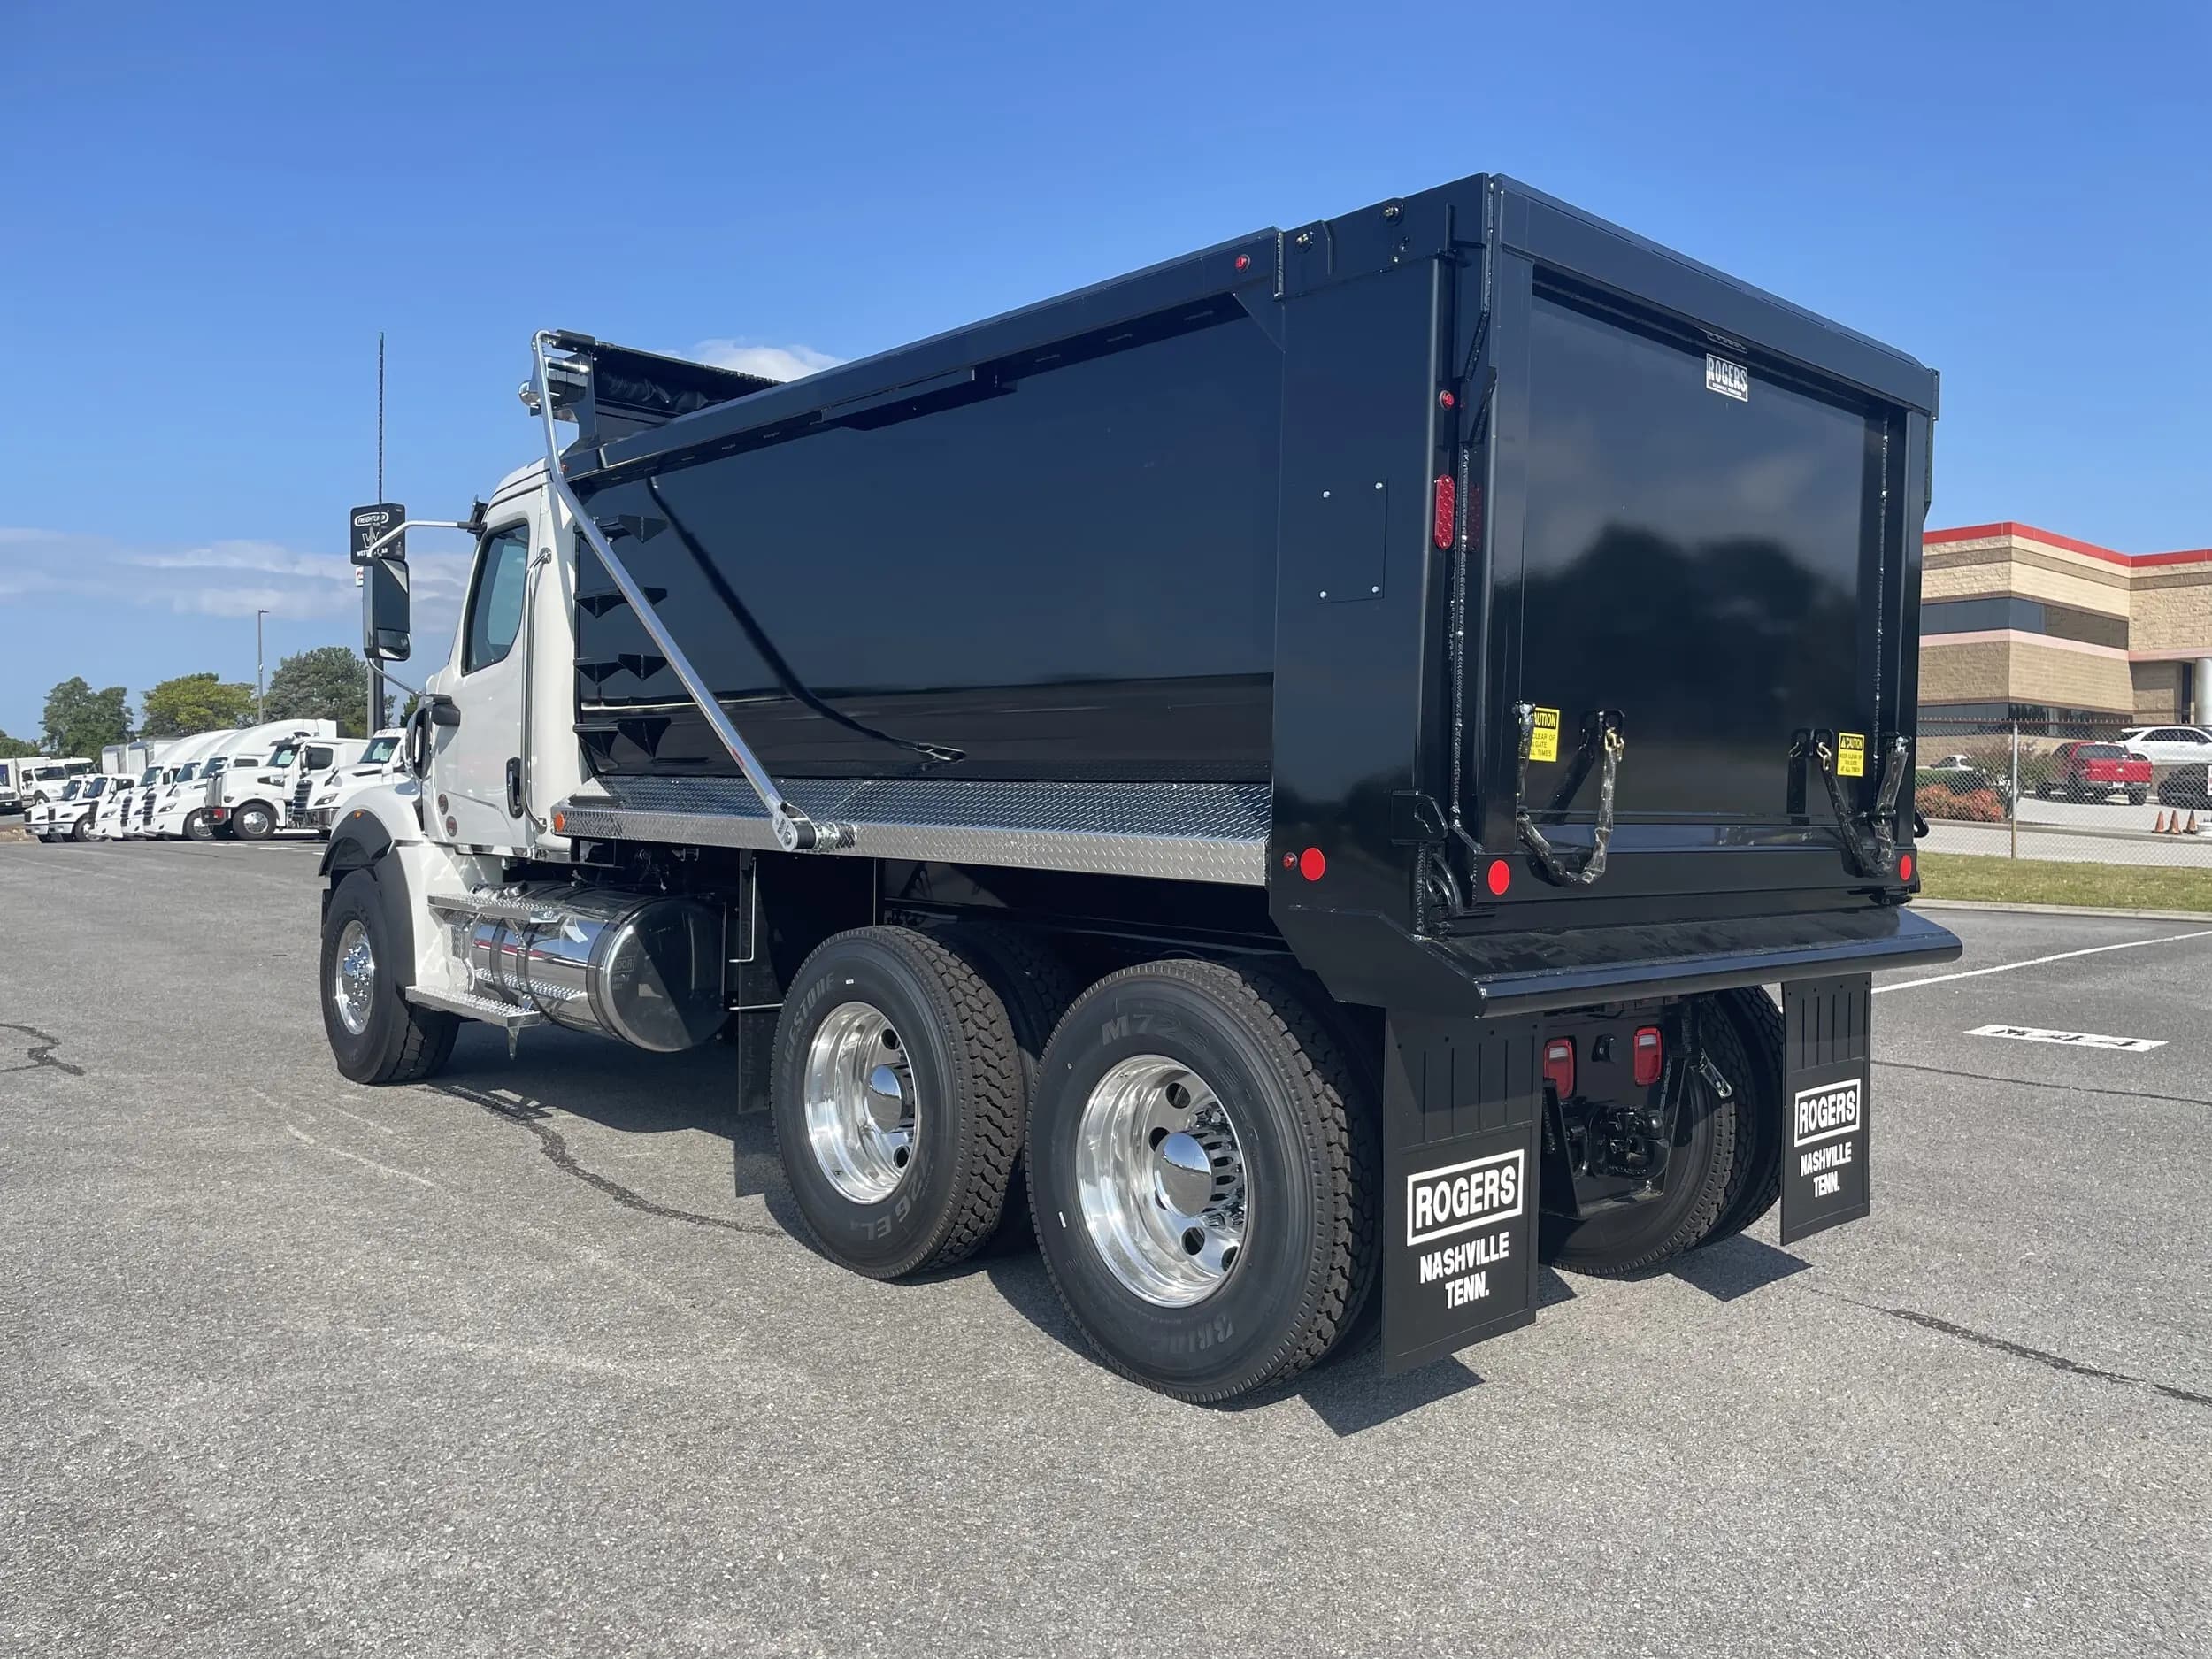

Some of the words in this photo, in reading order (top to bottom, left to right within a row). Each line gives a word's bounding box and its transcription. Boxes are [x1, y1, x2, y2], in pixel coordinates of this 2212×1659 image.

[1708, 357, 1747, 393] ROGERS
[1799, 1090, 1855, 1134] ROGERS
[1801, 1141, 1852, 1177] NASHVILLE
[1416, 1165, 1516, 1229] ROGERS
[1813, 1171, 1840, 1198] TENN.
[1420, 1231, 1509, 1284] NASHVILLE
[1445, 1271, 1490, 1310] TENN.
